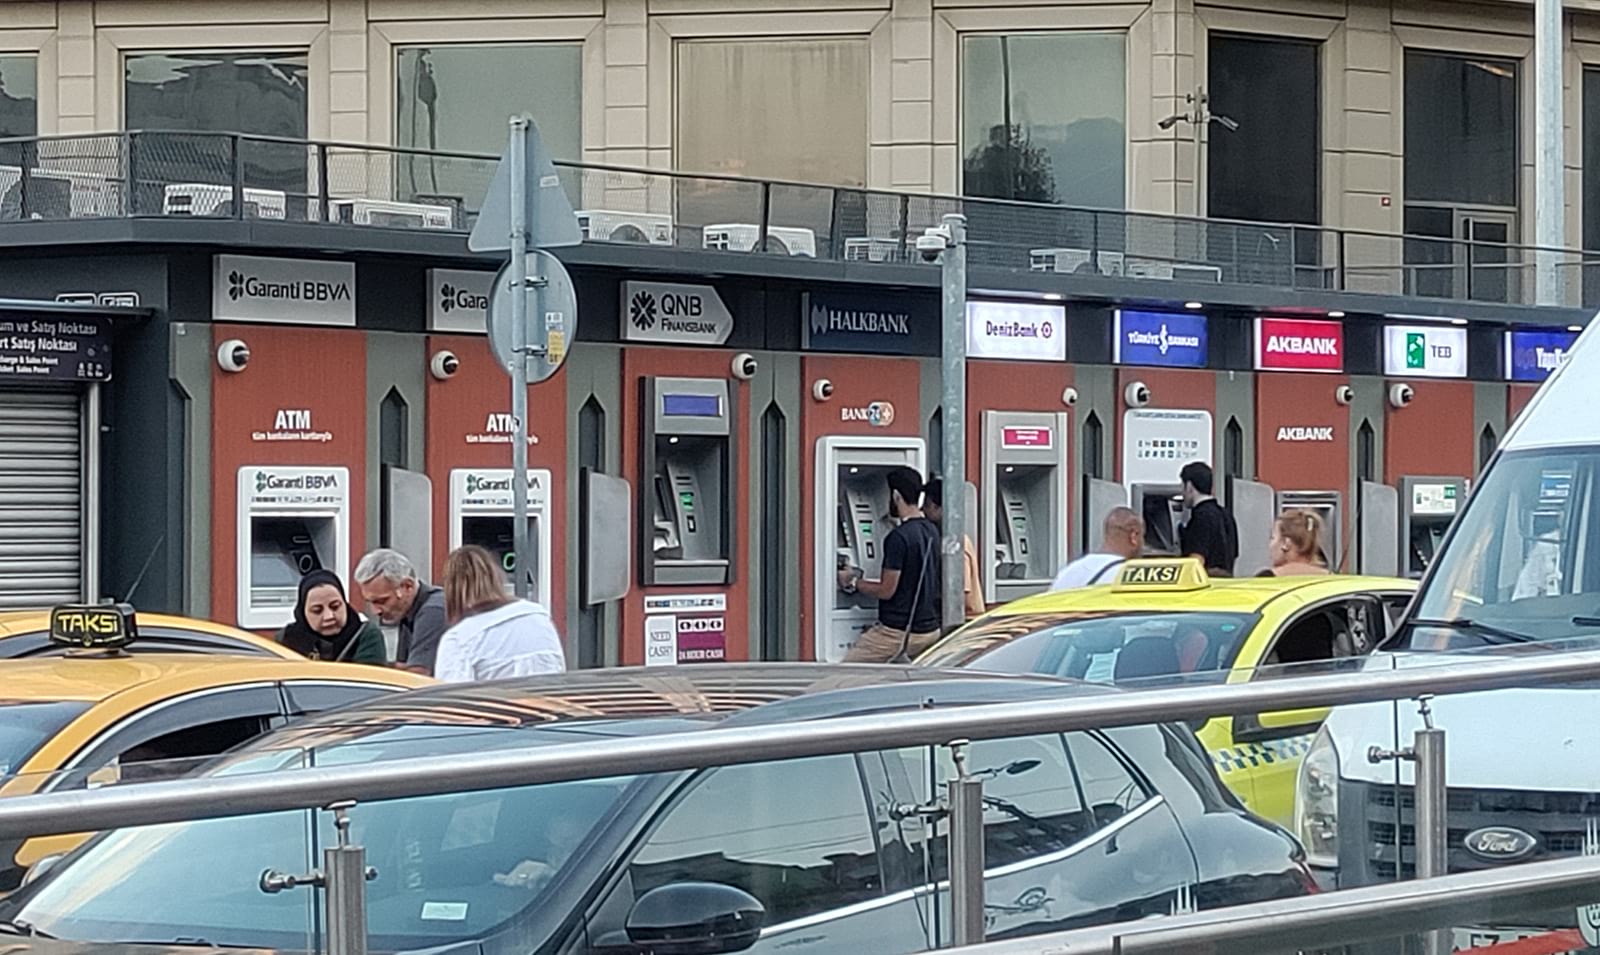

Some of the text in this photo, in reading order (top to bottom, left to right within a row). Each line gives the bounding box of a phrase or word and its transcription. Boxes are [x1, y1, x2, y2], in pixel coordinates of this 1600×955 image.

[245, 277, 351, 301] Garanti BBVA
[456, 290, 489, 309] Gara
[661, 293, 702, 316] QNB
[16, 322, 29, 332] ve
[31, 320, 56, 336] Satış
[58, 321, 97, 335] Noktası
[829, 309, 908, 334] HALKBANK
[986, 320, 1038, 337] DenizBank
[11, 337, 36, 353] Satış
[38, 337, 77, 351] Noktası
[1266, 335, 1338, 355] AKBANK
[1430, 344, 1452, 358] TEB
[274, 410, 311, 430] ATM
[842, 408, 869, 420] BANK
[1277, 427, 1333, 441] AKBANK
[267, 474, 337, 489] Garanti BBVA
[1478, 832, 1519, 852] Ford
